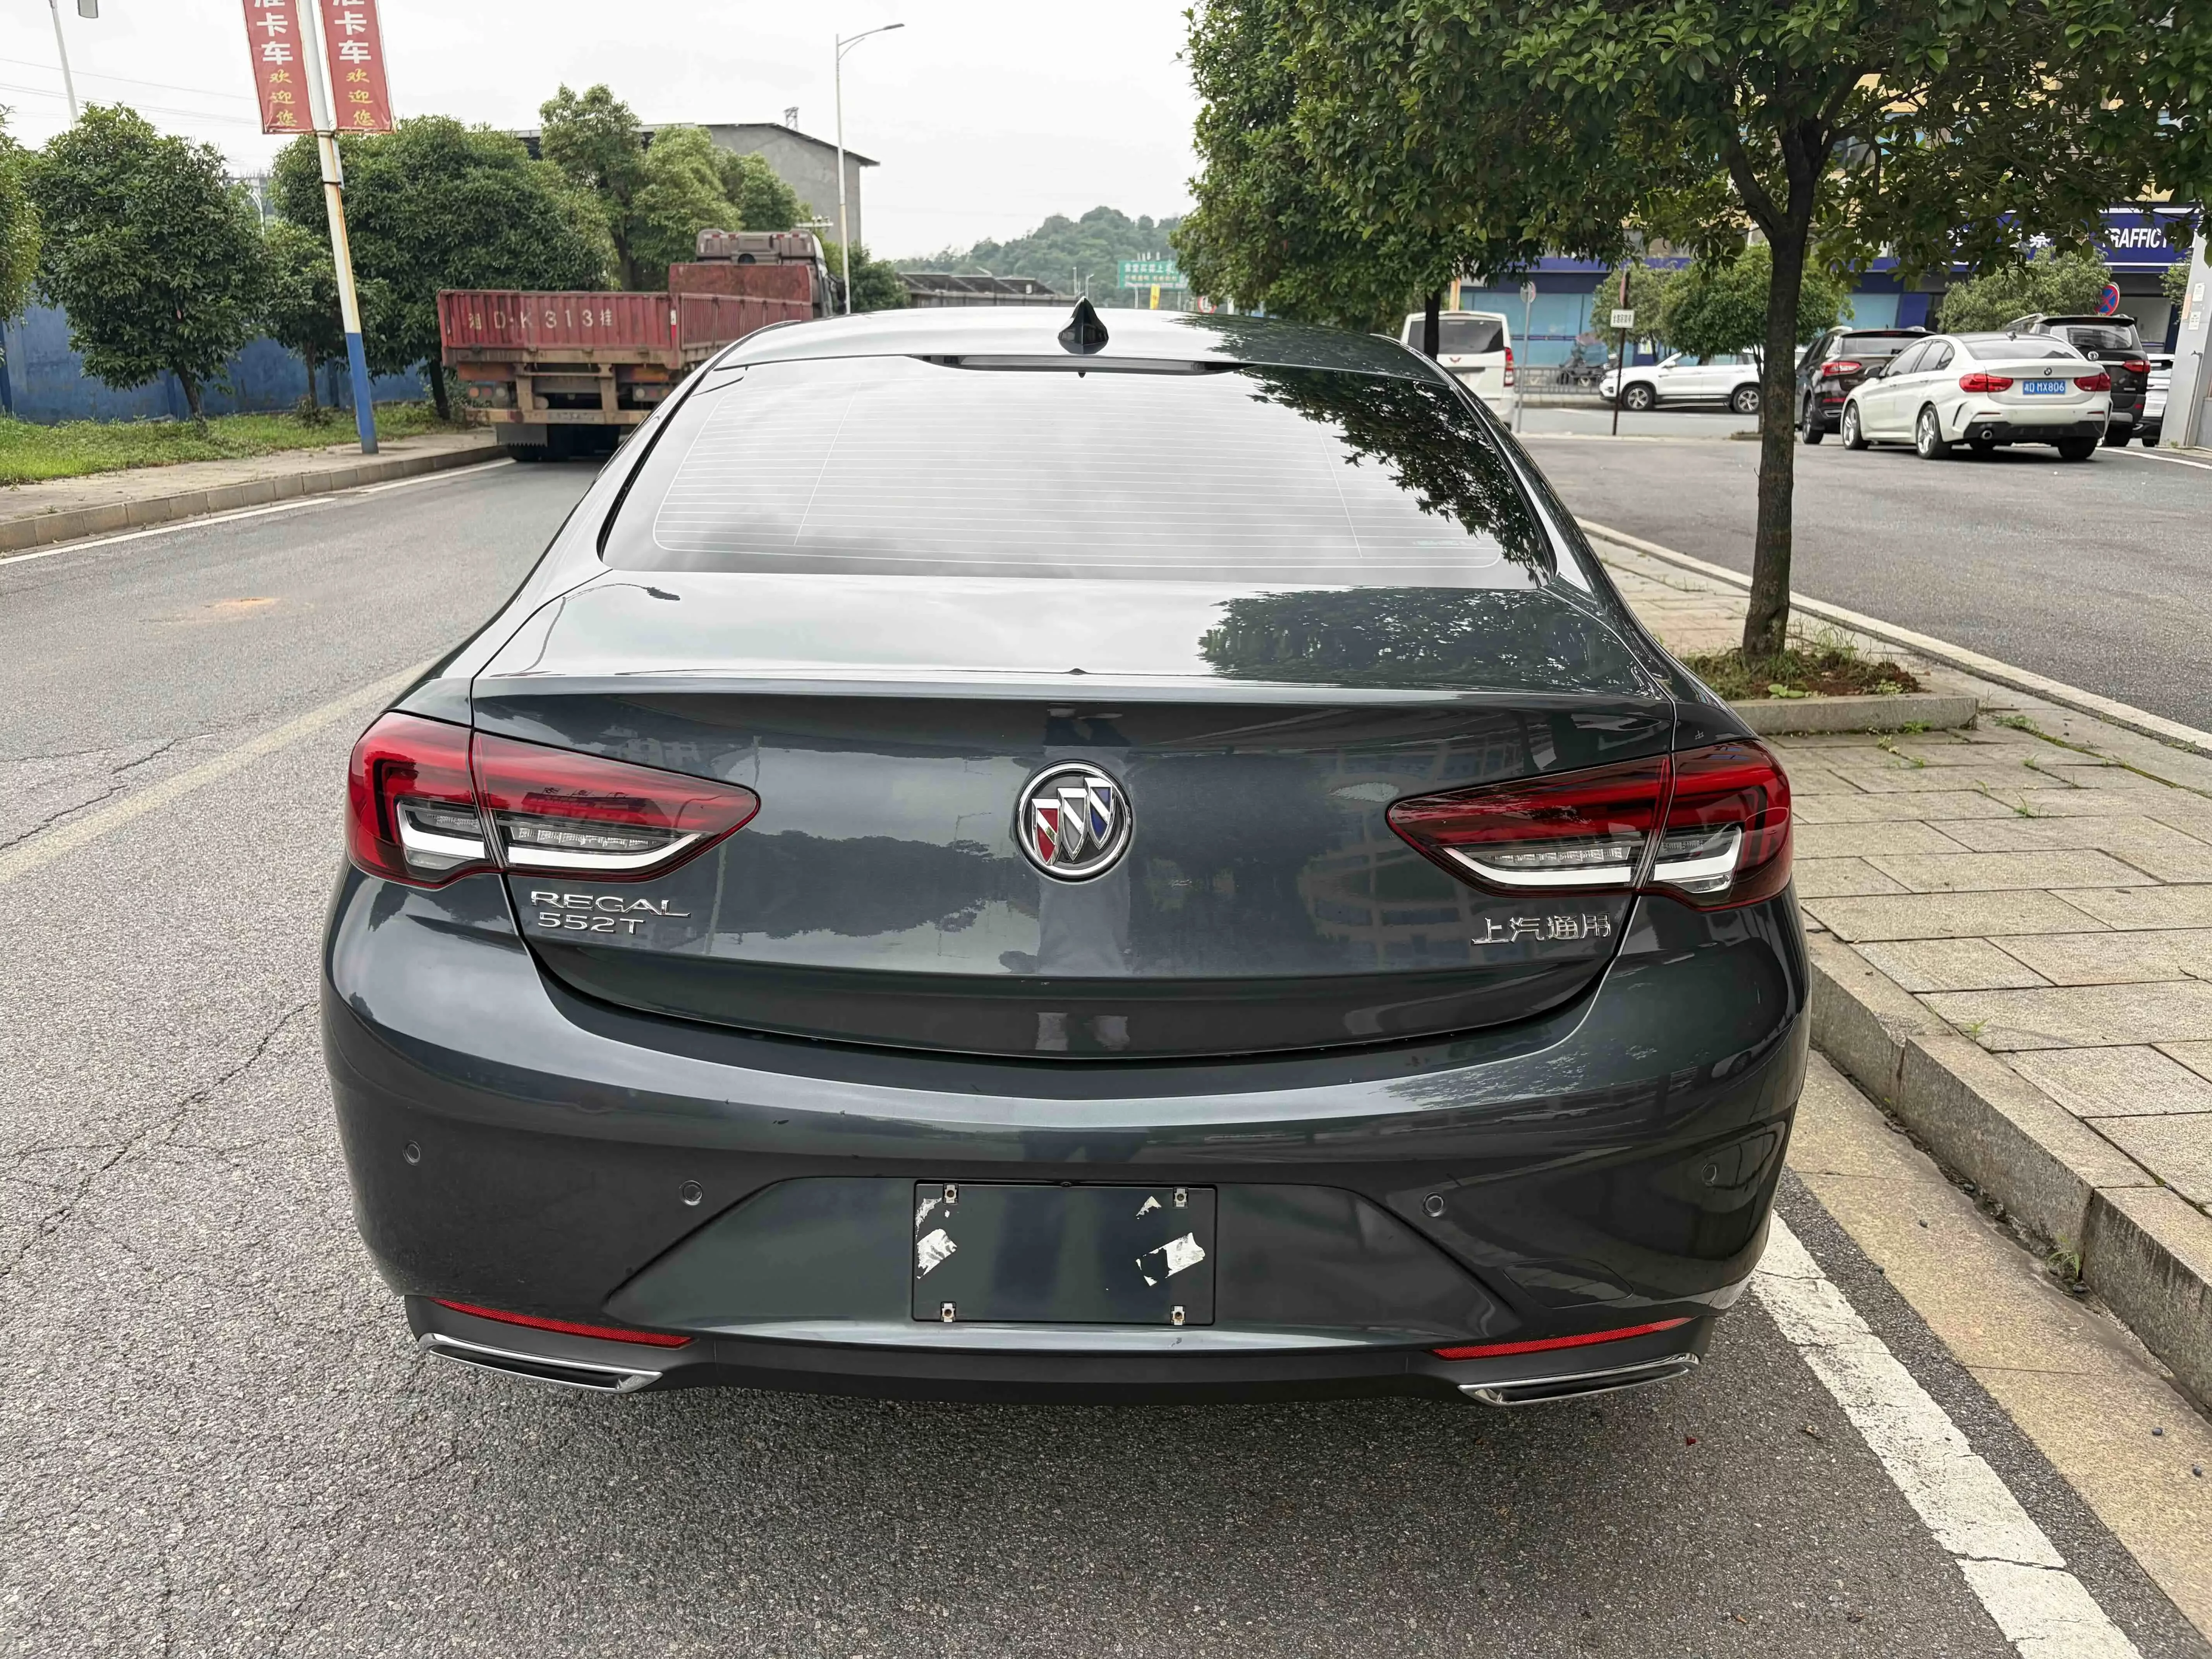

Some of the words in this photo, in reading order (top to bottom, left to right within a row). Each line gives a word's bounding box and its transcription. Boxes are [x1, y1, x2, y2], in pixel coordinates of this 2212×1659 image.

[270, 69, 298, 127] 欢迎您
[346, 69, 375, 126] 欢迎您
[531, 891, 691, 917] REGAL
[538, 912, 645, 934] 552T
[1471, 912, 1611, 945] 上汽通用
